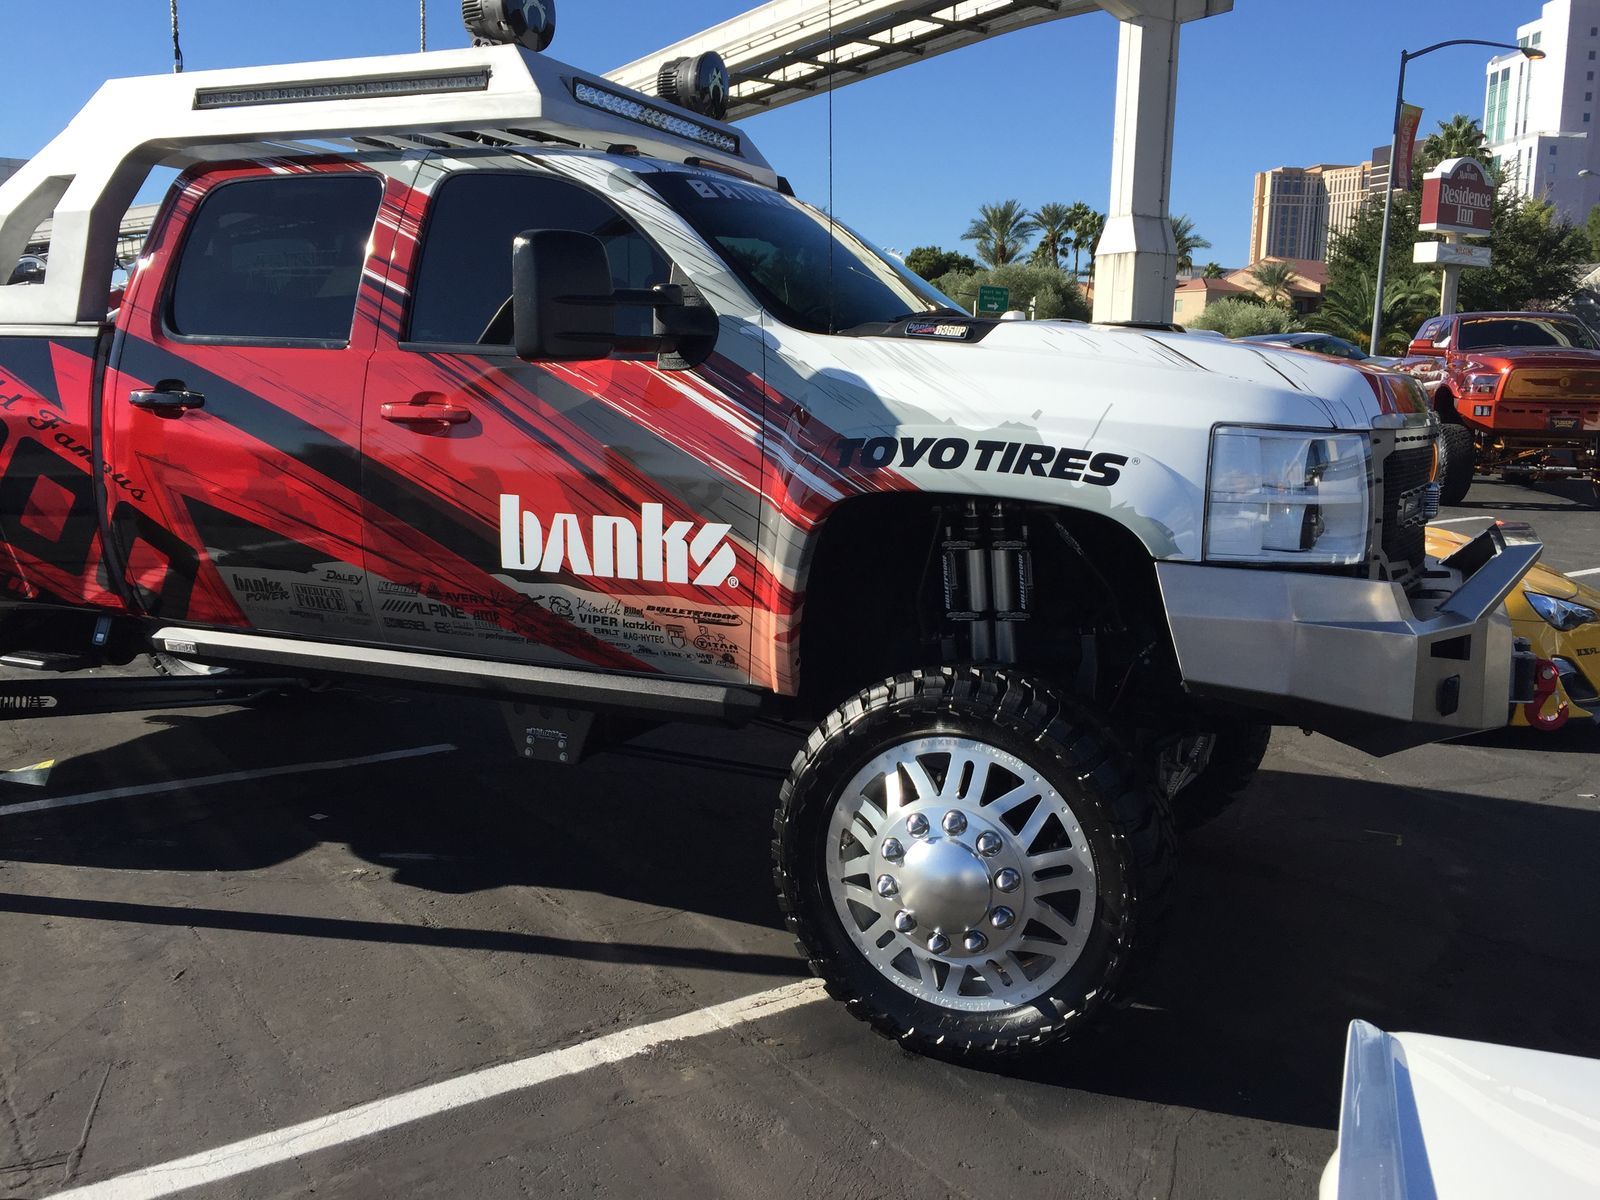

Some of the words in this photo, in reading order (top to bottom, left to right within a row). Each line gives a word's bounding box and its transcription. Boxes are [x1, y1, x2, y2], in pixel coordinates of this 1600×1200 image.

[1440, 183, 1492, 208] Residence
[1456, 204, 1474, 224] Inn
[836, 437, 969, 469] TOYO
[974, 439, 1129, 487] TIRES
[500, 494, 737, 587] banks
[246, 590, 290, 602] POWER
[294, 584, 343, 599] AMERICAN
[296, 594, 346, 612] FORCE
[408, 600, 467, 619] ALPINE
[579, 613, 618, 627] VIPER
[646, 605, 740, 620] BULLETPROOF
[623, 618, 662, 632] katzkin
[623, 631, 665, 645] MAG-HYTEC
